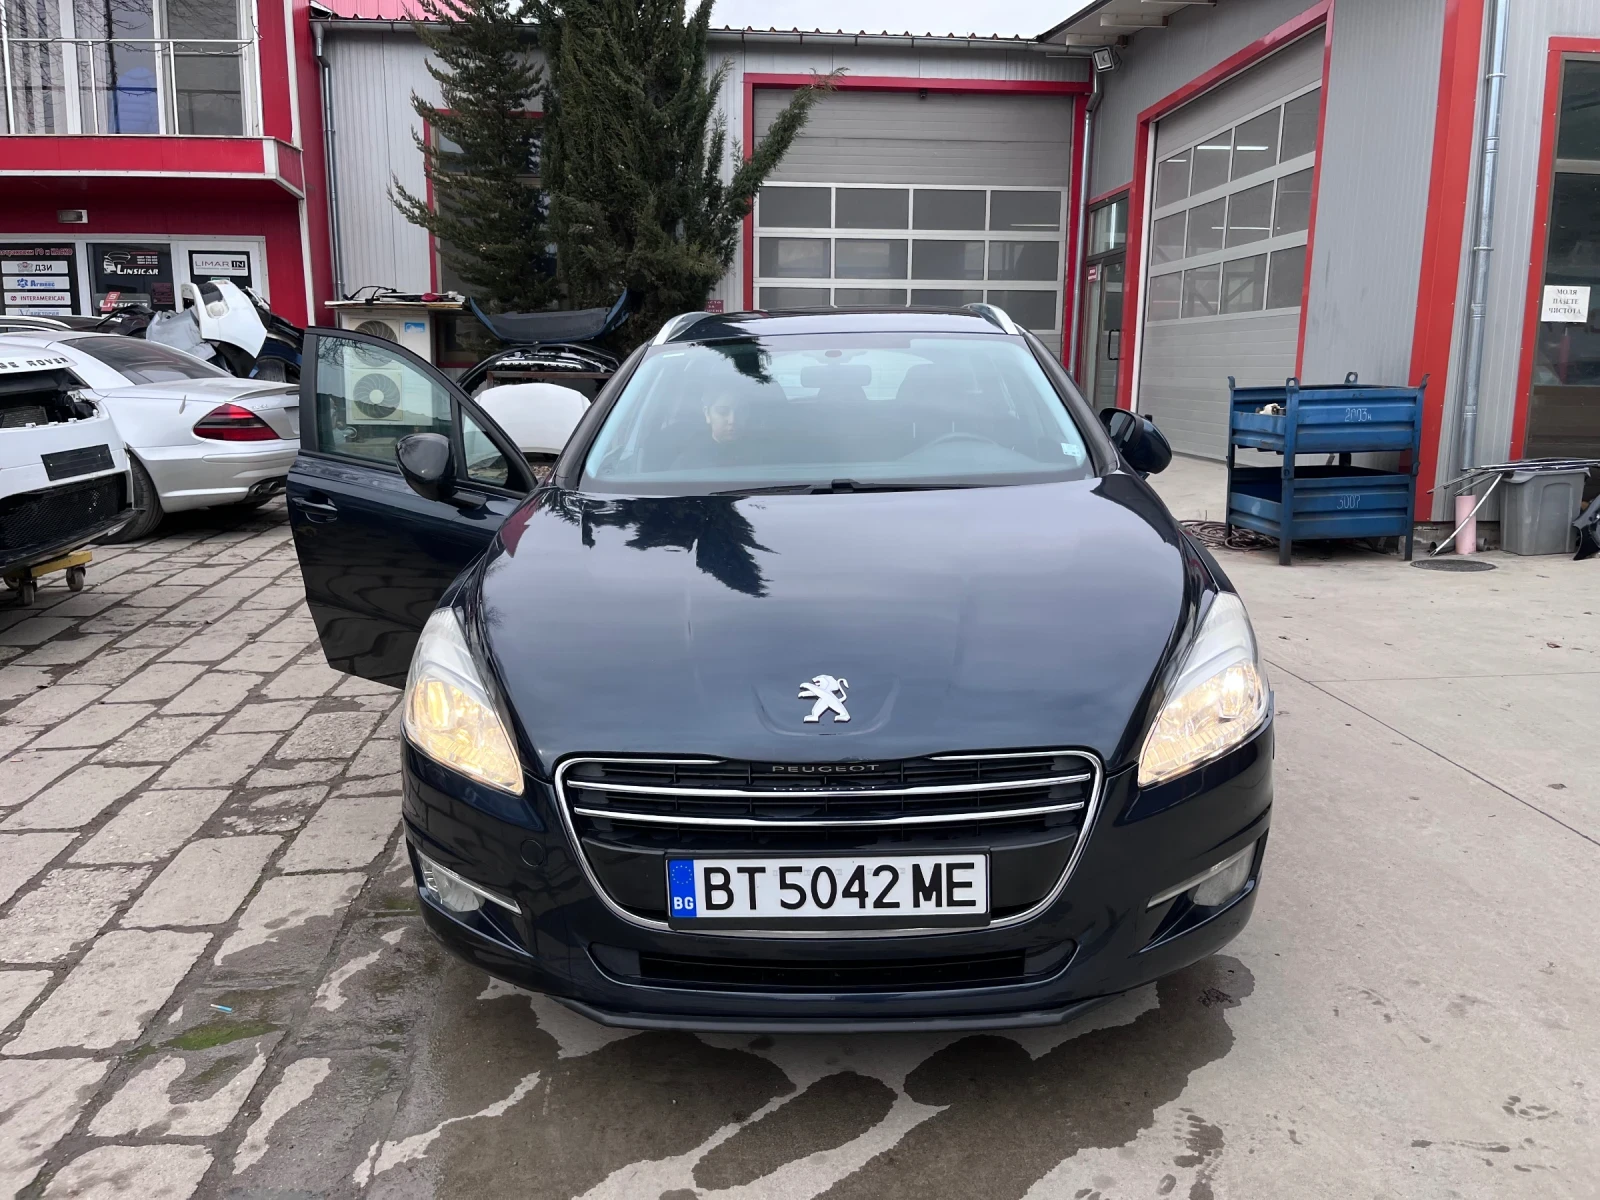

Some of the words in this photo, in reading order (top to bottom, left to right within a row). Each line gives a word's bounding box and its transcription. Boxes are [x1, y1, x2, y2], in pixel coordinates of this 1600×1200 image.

[35, 264, 53, 272] ДЗИ
[26, 357, 69, 367] ROVER
[772, 764, 880, 773] PEUGEOT
[703, 866, 767, 911] BT
[778, 864, 901, 910] 5042
[911, 862, 977, 908] ME
[673, 896, 694, 910] BG
